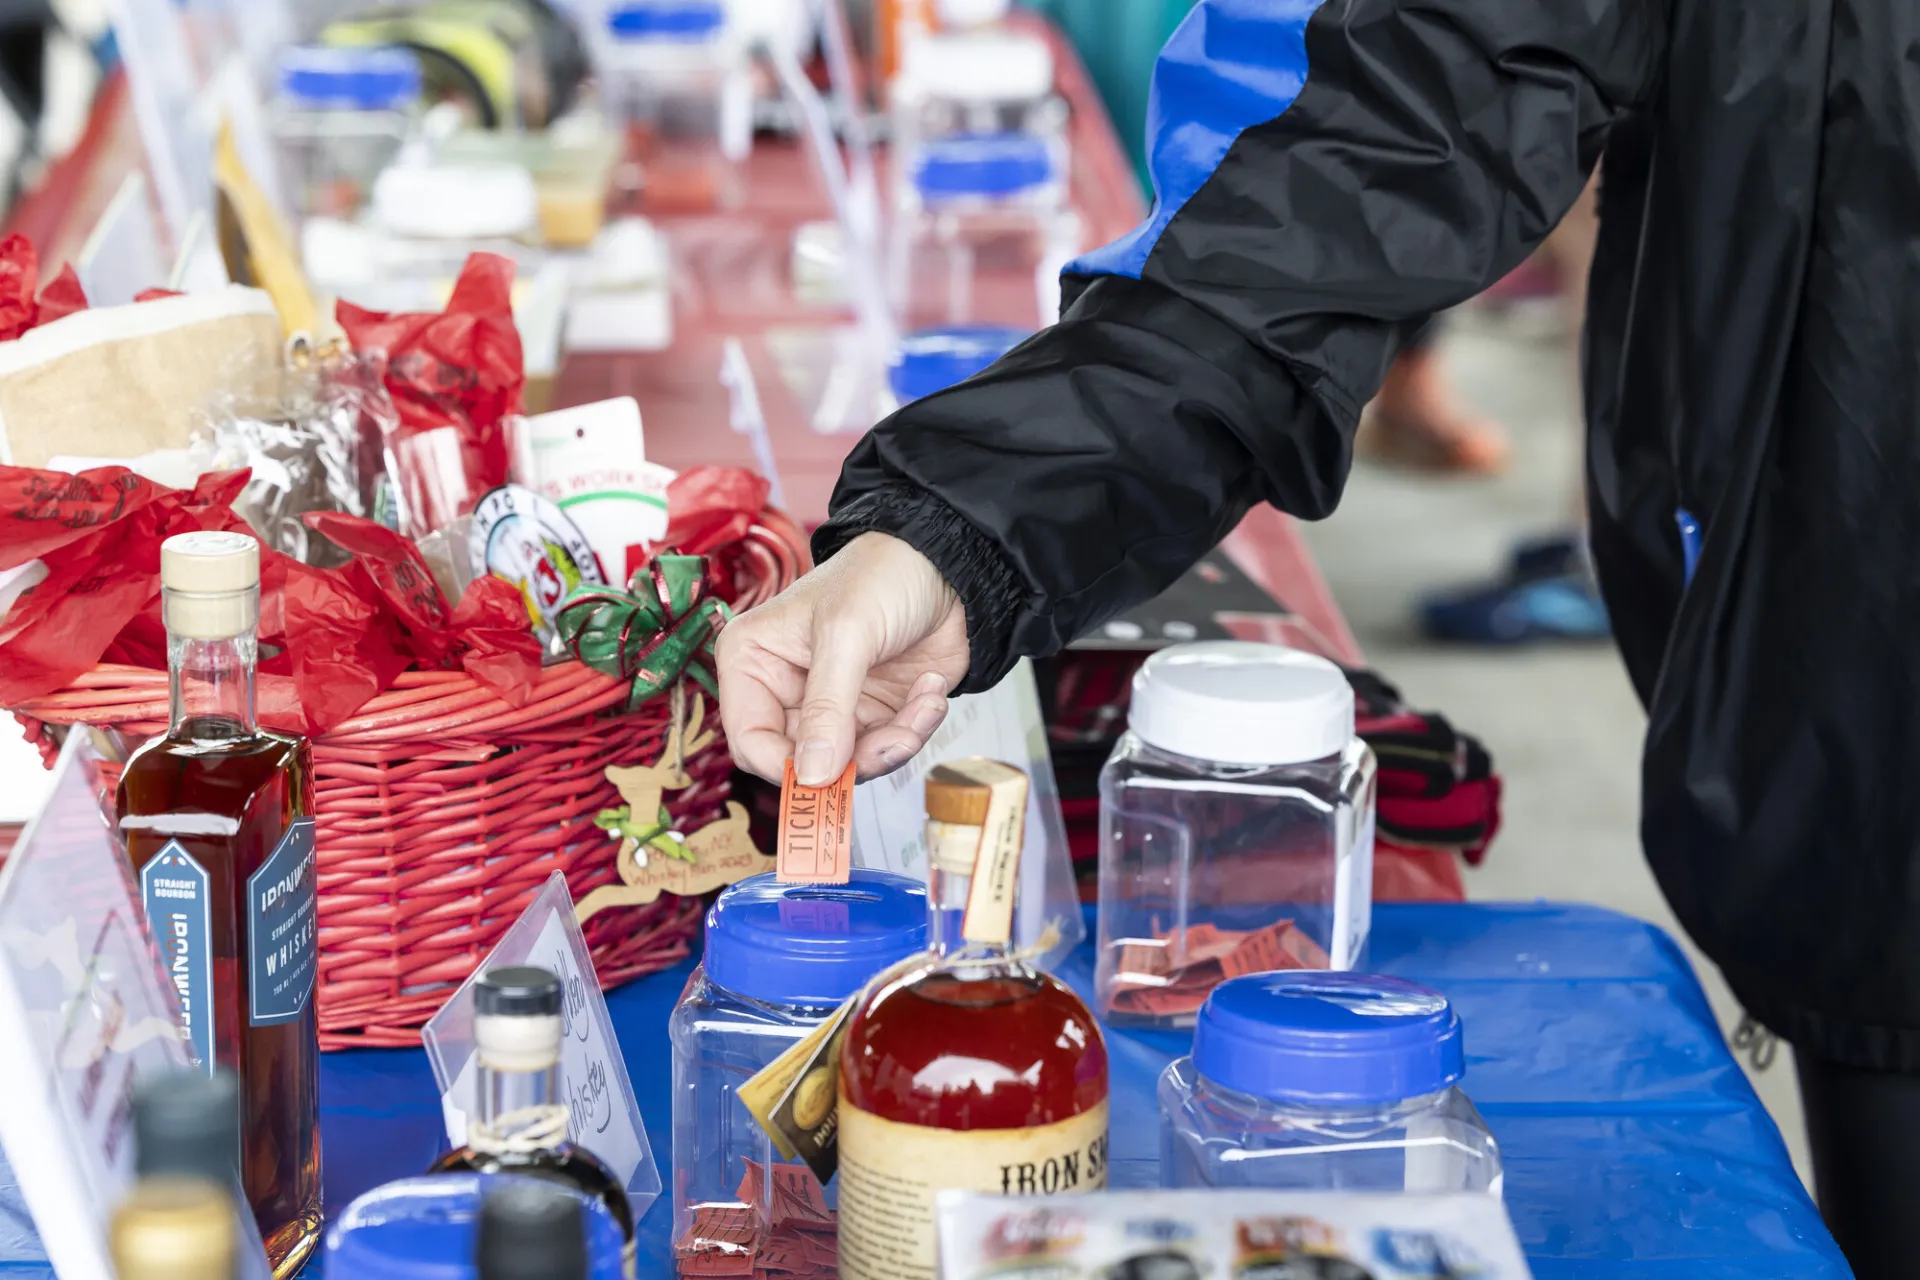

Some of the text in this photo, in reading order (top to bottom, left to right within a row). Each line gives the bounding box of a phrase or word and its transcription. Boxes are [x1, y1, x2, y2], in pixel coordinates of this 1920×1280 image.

[153, 878, 197, 889] STRAIGHT
[154, 888, 196, 899] BOURBON
[271, 912, 297, 940] STRAIGHT
[1000, 1149, 1080, 1197] IRON
